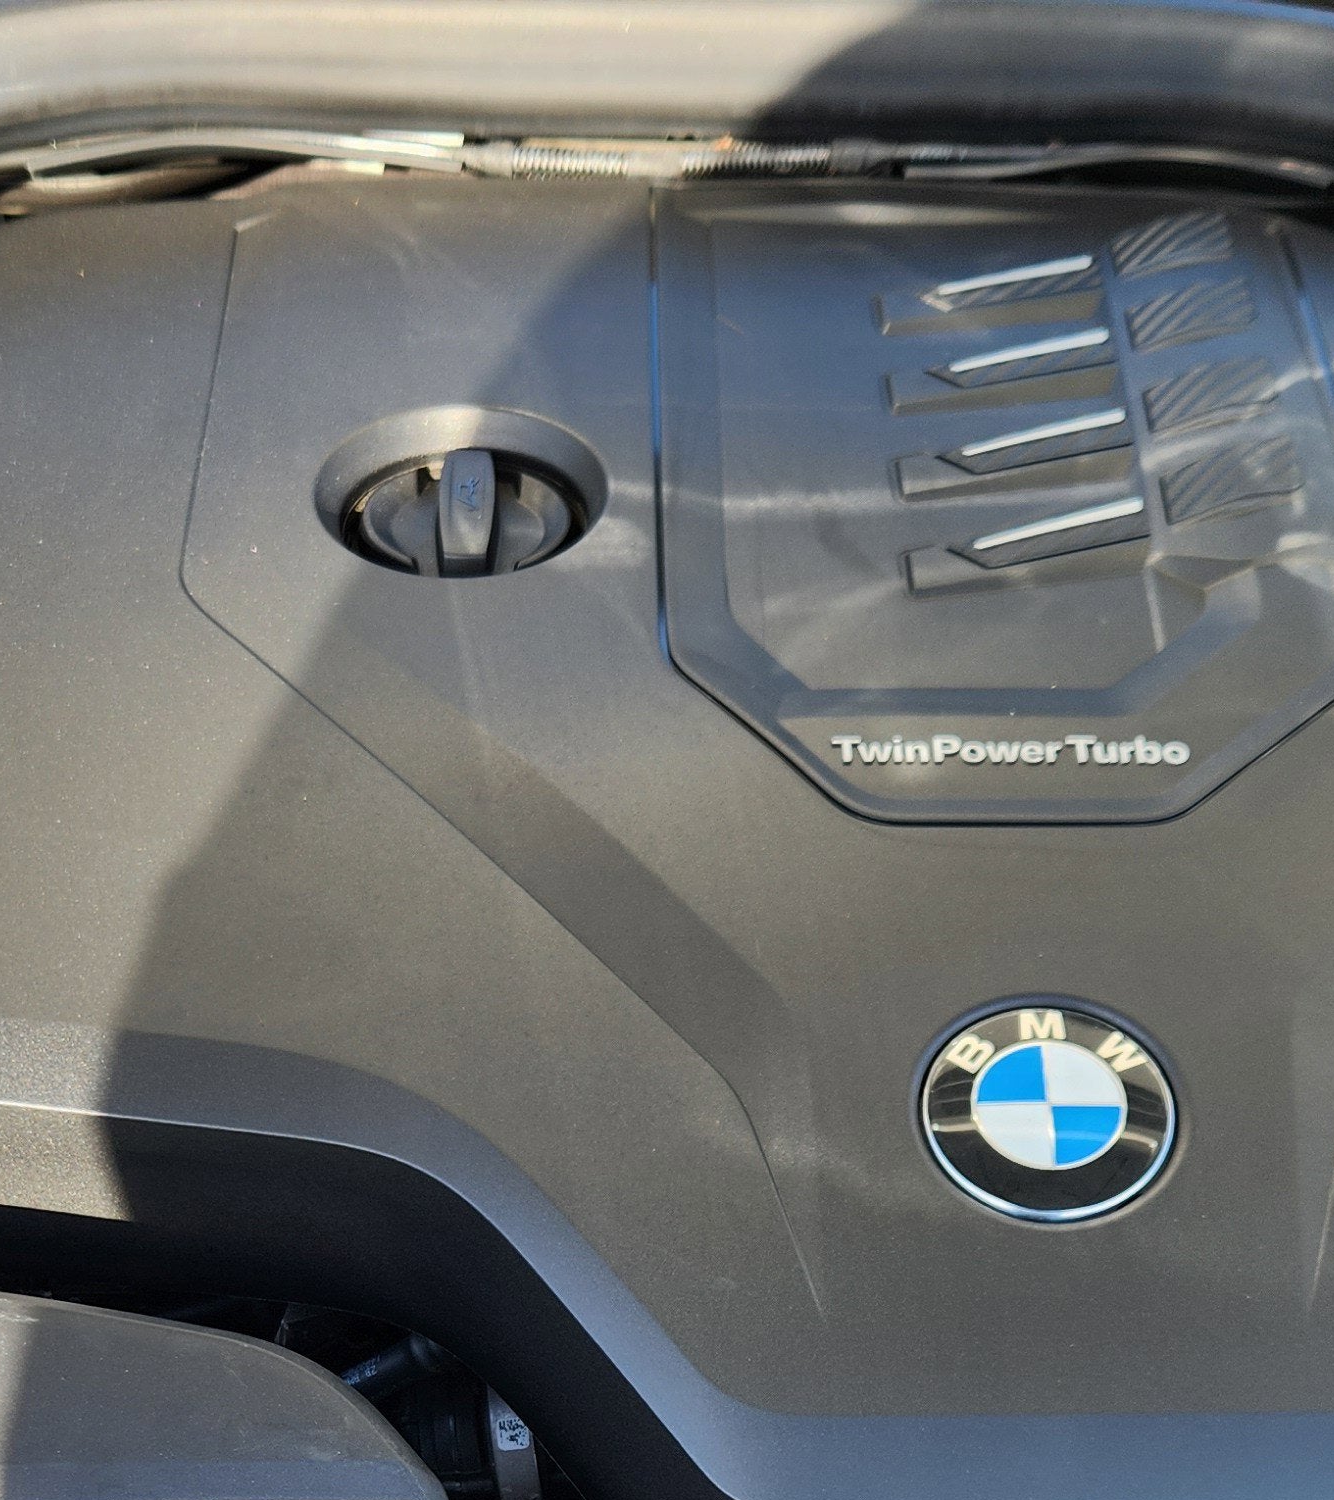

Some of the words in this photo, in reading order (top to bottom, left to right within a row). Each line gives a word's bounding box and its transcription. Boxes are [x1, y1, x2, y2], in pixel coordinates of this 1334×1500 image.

[831, 734, 1062, 765] TwinPower
[1065, 734, 1191, 765] Turbo
[946, 1009, 1149, 1075] BMW
